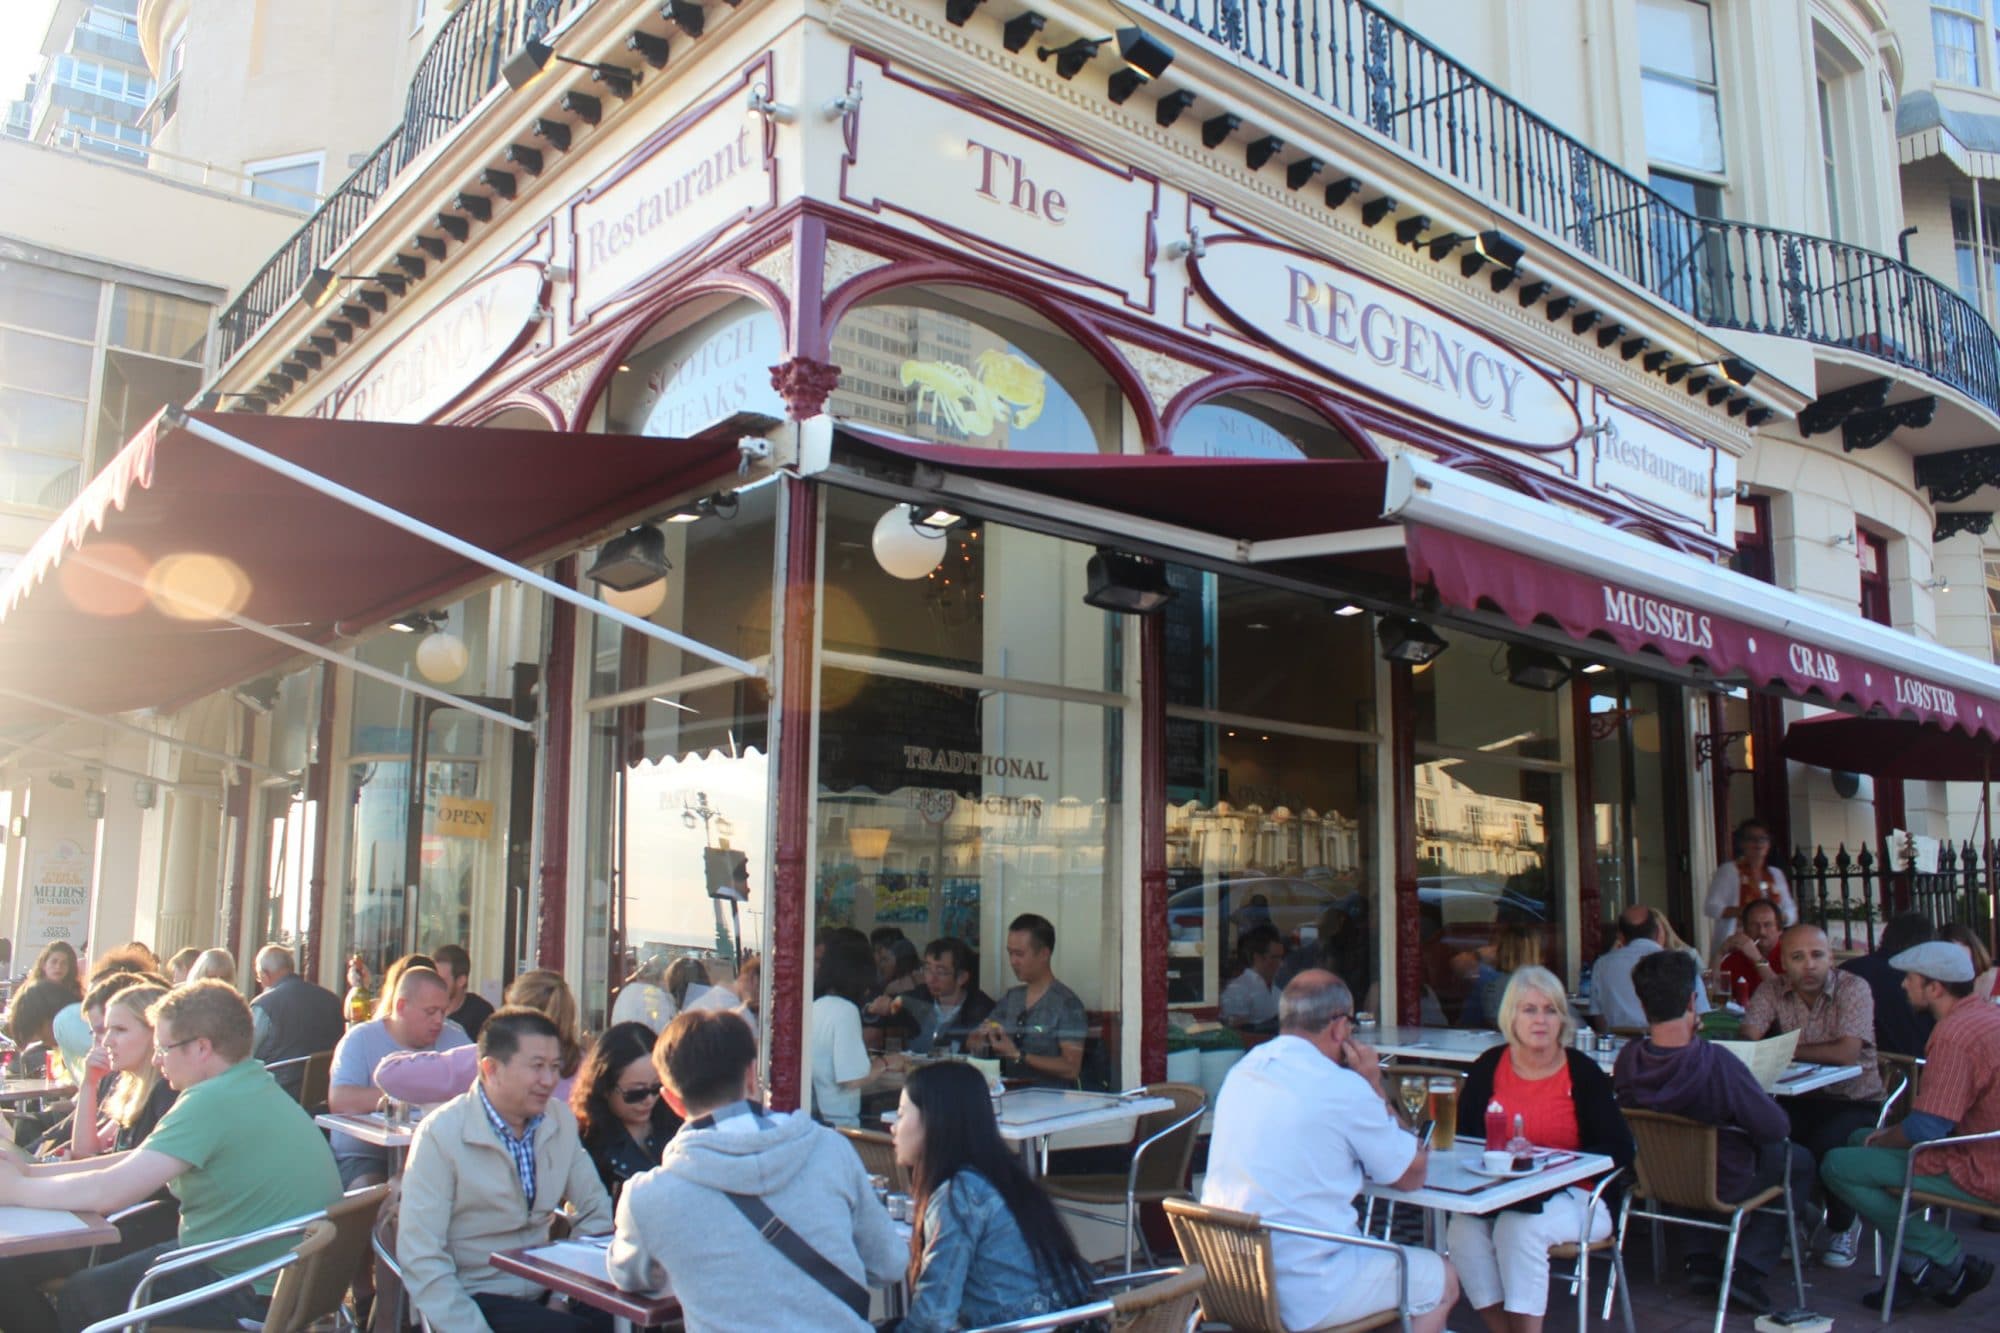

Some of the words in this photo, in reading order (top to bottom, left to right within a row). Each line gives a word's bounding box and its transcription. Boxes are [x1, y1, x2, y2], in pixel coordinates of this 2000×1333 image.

[585, 122, 752, 270] Restaurant
[966, 138, 1068, 223] The
[648, 319, 757, 395] SCOTCH
[1285, 265, 1527, 423] REGENCY
[1603, 424, 1708, 496] Restaurant
[1602, 586, 1713, 650] MUSSELS
[1789, 643, 1840, 683] CRAB
[1894, 676, 1957, 716] LOBSTER
[904, 745, 1050, 781] TRADITIONAL
[438, 806, 487, 826] OPEN
[984, 795, 1042, 818] CHIPS
[33, 885, 88, 897] MELROSE
